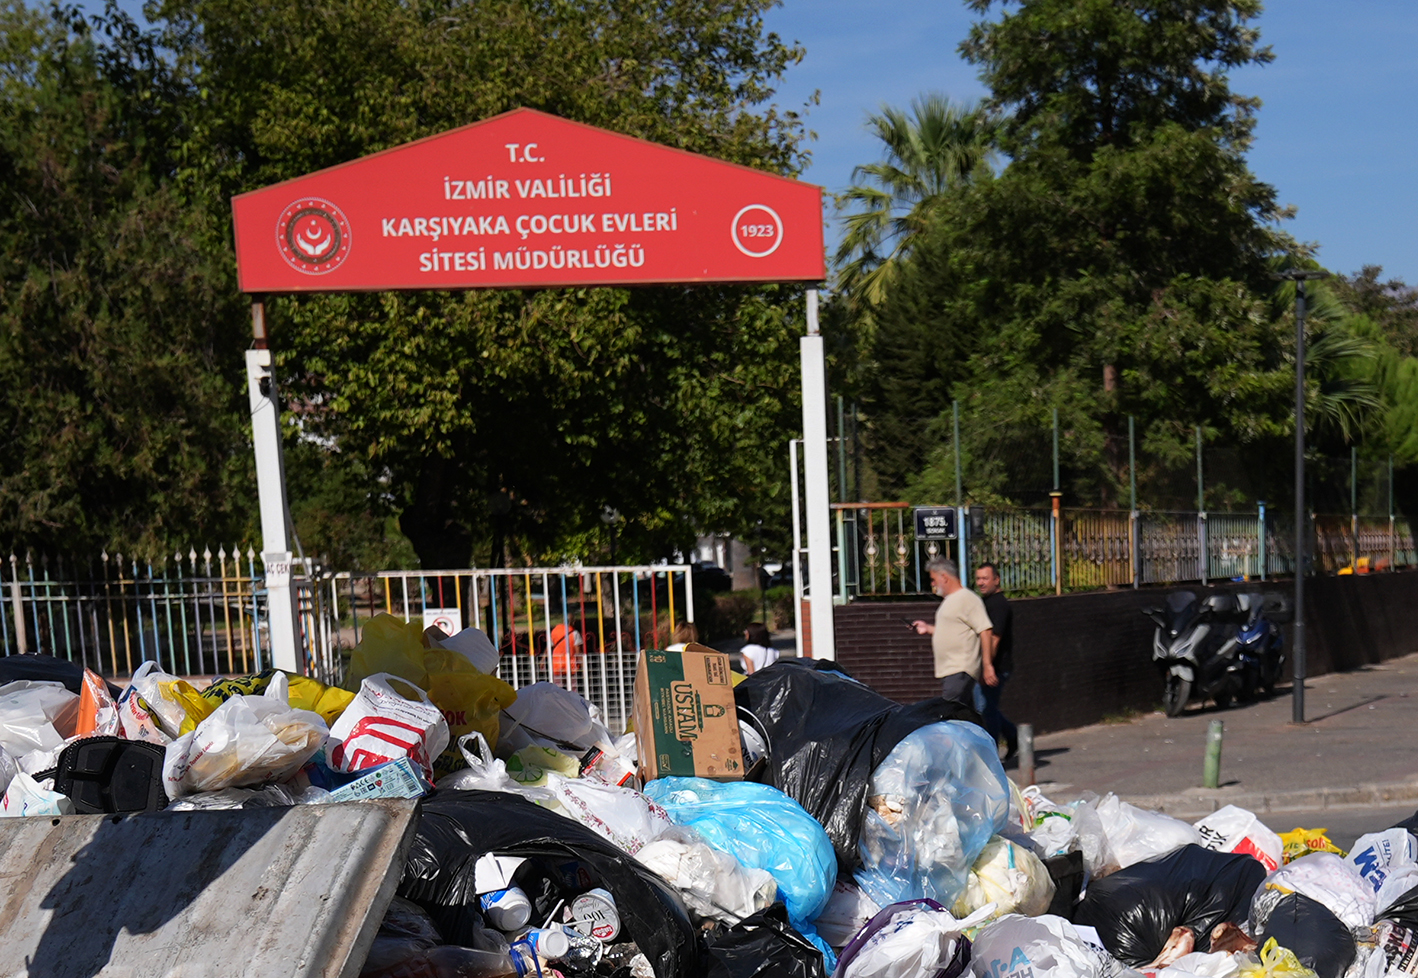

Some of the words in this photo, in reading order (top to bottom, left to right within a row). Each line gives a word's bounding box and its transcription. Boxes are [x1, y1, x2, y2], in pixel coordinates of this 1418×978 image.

[504, 144, 545, 163] T.C.
[443, 176, 510, 200] İZMİR
[514, 173, 612, 199] VALİLİĞİ
[381, 215, 511, 241] KARŞIYAKA
[515, 212, 597, 239] ÇOCUK
[601, 208, 678, 233] EVLERİ
[740, 224, 775, 239] 1923
[419, 249, 486, 272] SİTESİ
[492, 243, 645, 271] MÜDÜRLÜĞÜ
[674, 684, 698, 741] USTAM
